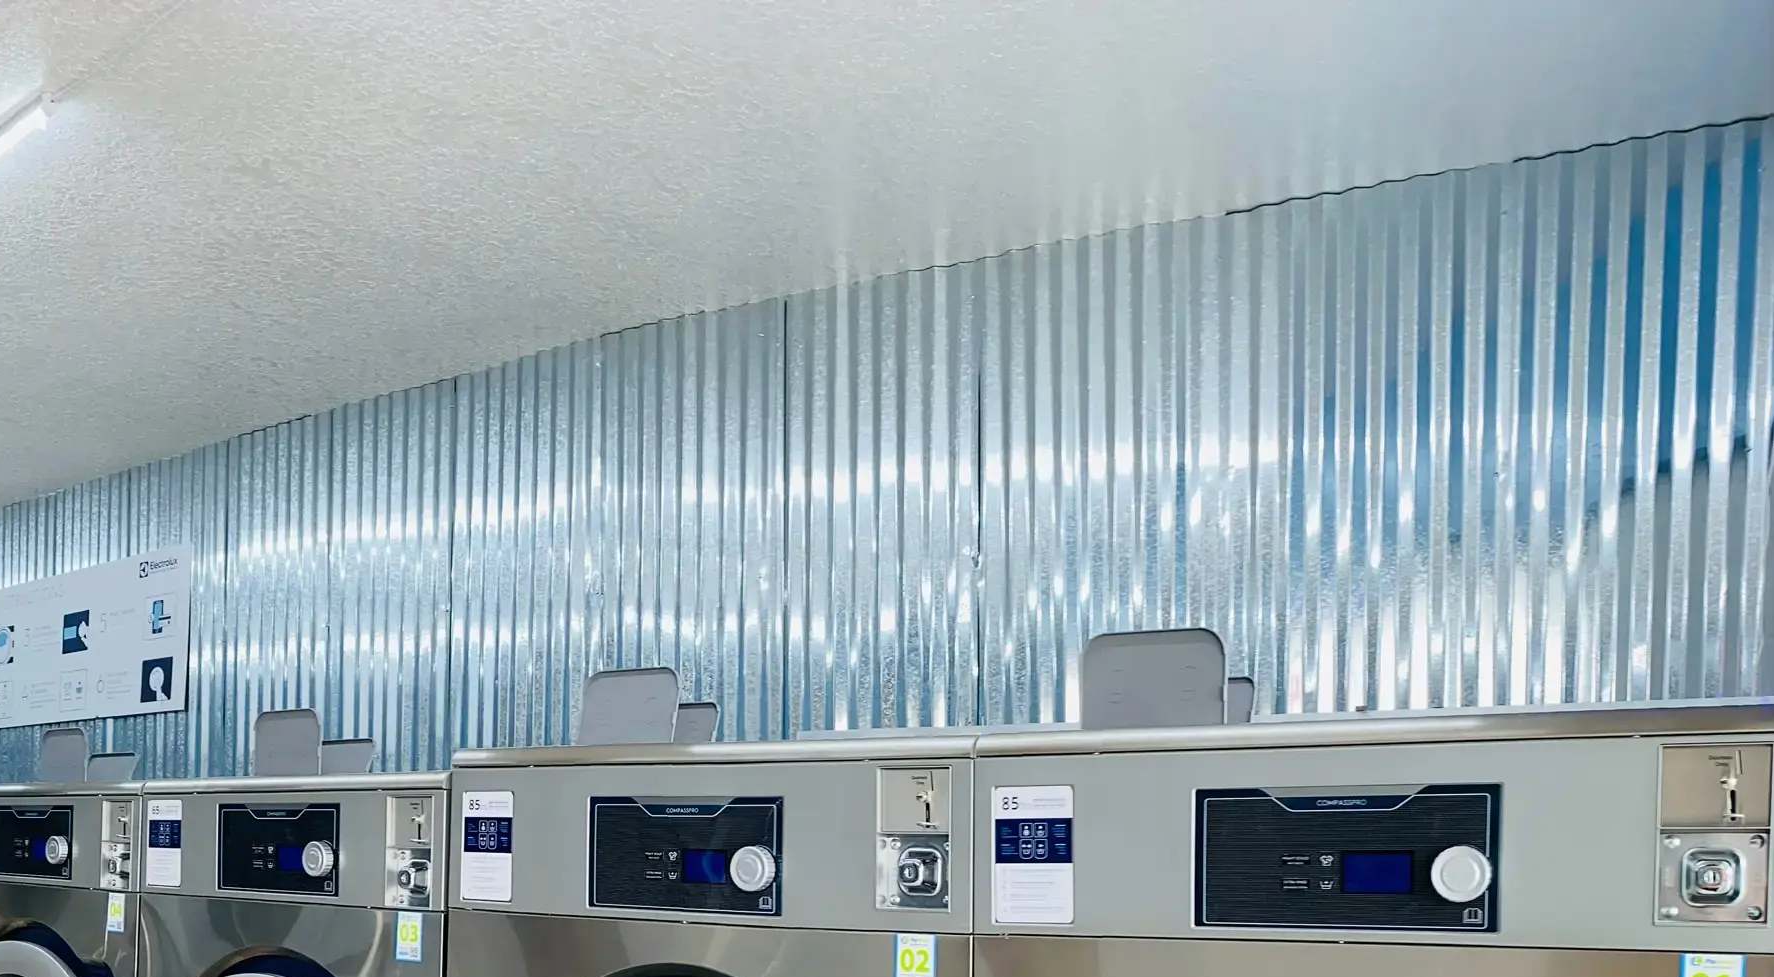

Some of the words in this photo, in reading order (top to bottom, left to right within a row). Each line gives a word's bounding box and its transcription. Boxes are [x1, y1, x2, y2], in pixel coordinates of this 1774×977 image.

[149, 557, 178, 571] Electrolux
[468, 799, 481, 810] 85
[1001, 796, 1020, 811] 85
[399, 923, 419, 943] 03
[899, 947, 930, 973] 02
